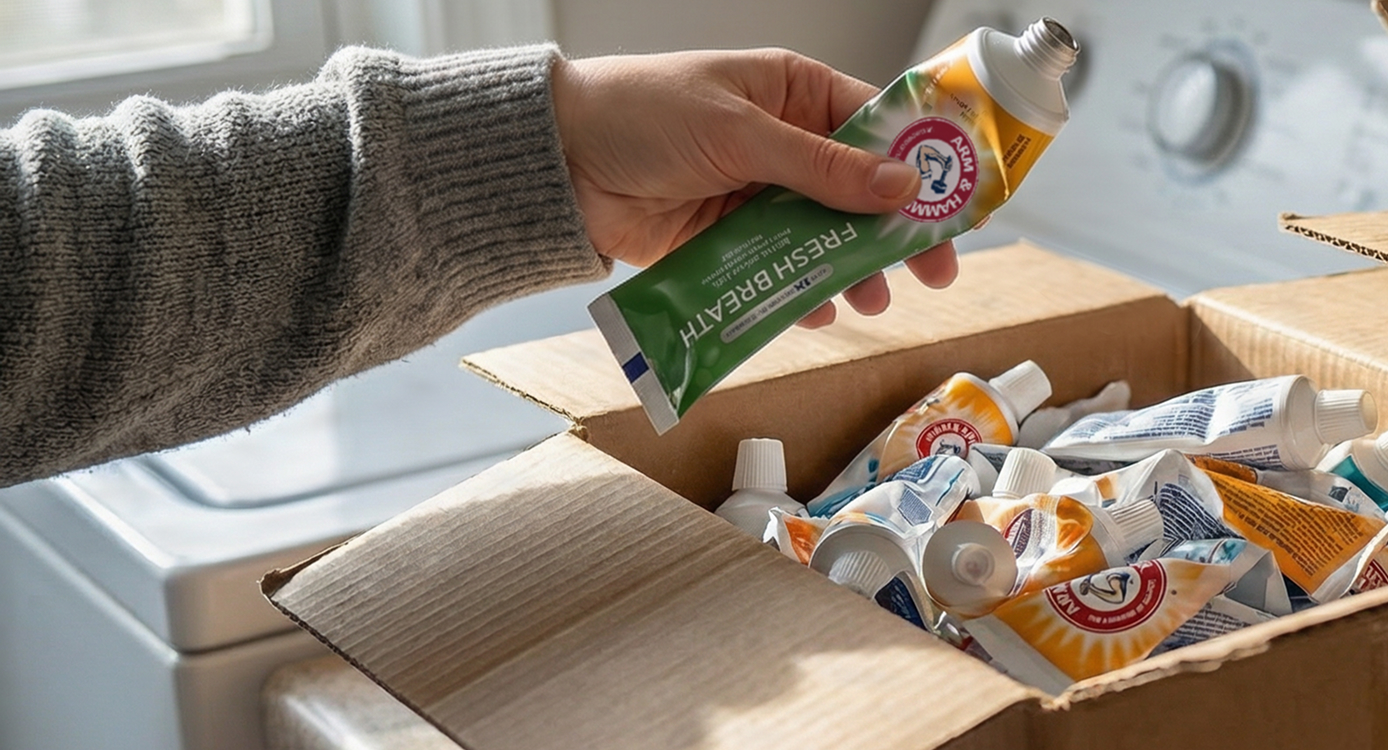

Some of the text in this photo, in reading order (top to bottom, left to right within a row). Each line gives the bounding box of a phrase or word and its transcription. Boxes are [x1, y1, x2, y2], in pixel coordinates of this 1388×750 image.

[949, 136, 974, 173] ARM
[959, 178, 972, 192] &
[905, 193, 962, 217] HAMM
[772, 221, 858, 281] FRESH
[679, 268, 774, 349] BREATH
